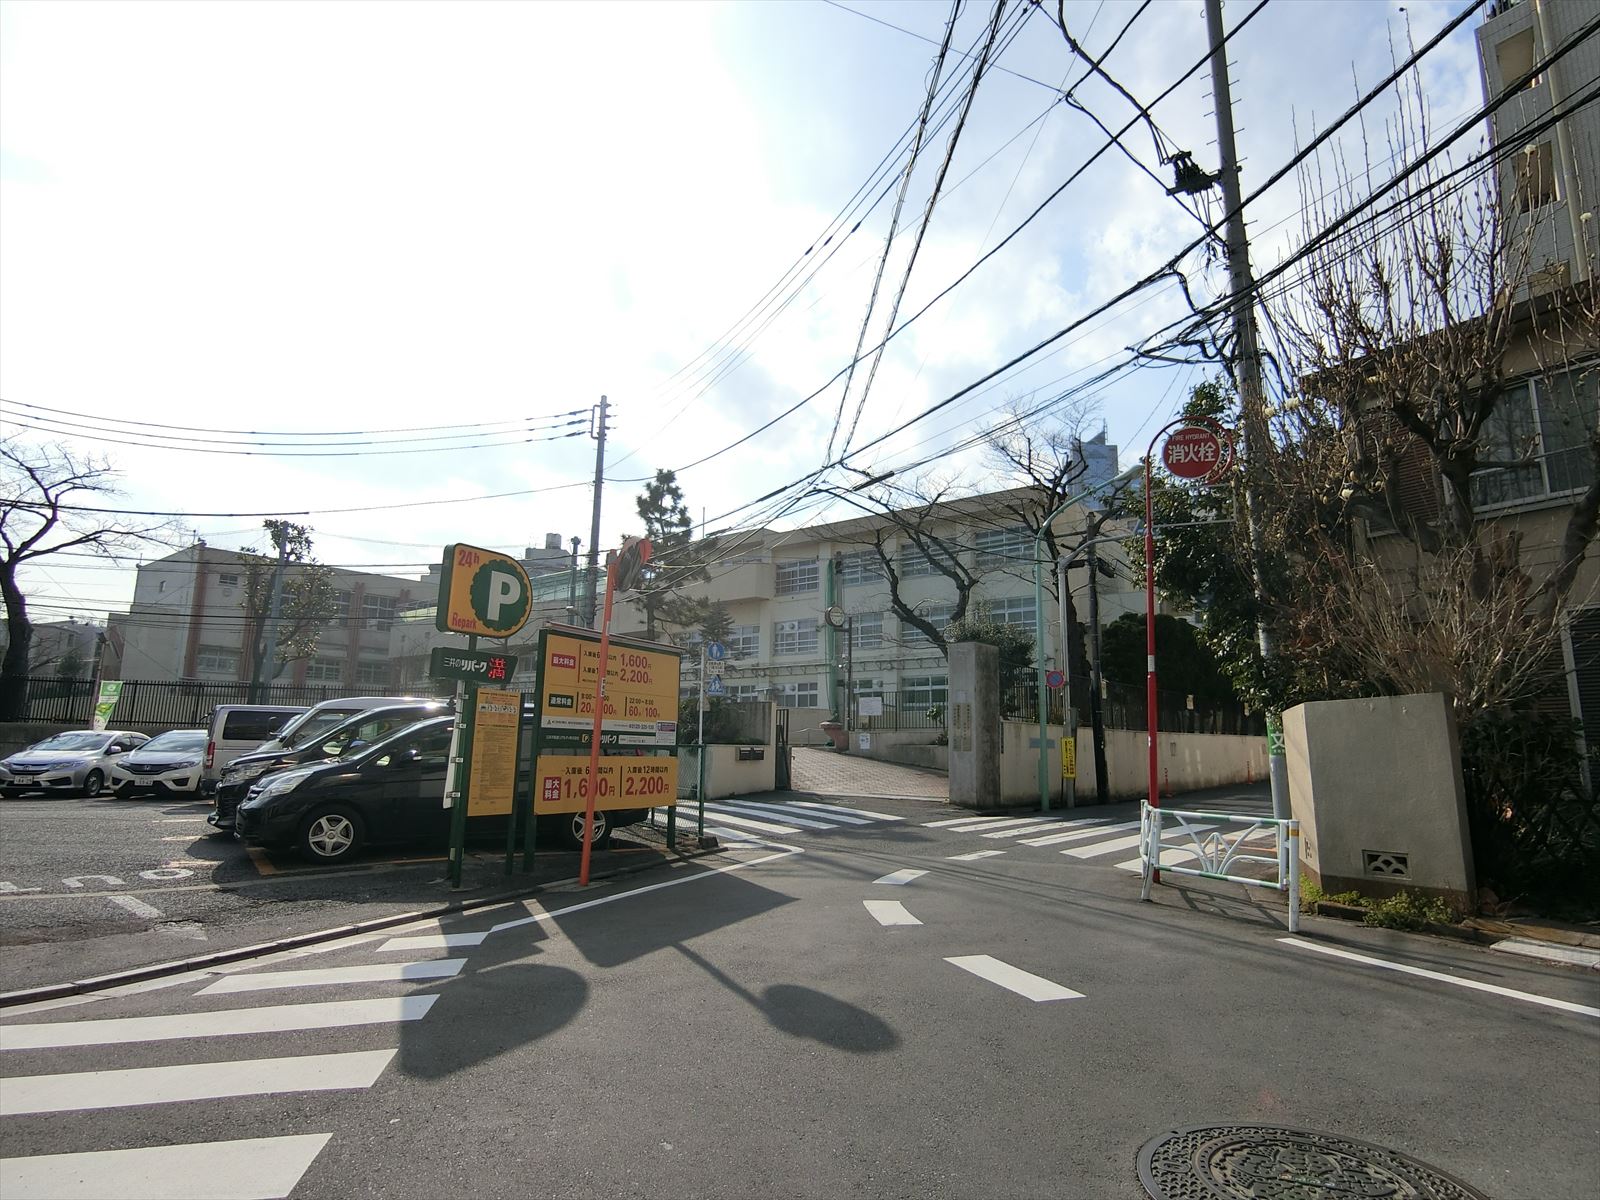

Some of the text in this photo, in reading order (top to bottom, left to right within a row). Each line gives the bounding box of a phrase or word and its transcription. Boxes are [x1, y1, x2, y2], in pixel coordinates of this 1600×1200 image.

[1168, 441, 1216, 464] 消火栓
[458, 549, 480, 568] 24h
[486, 570, 521, 621] P
[452, 612, 477, 630] Repark
[443, 657, 487, 672] 三井のリパーク
[625, 776, 669, 796] 2,200円
